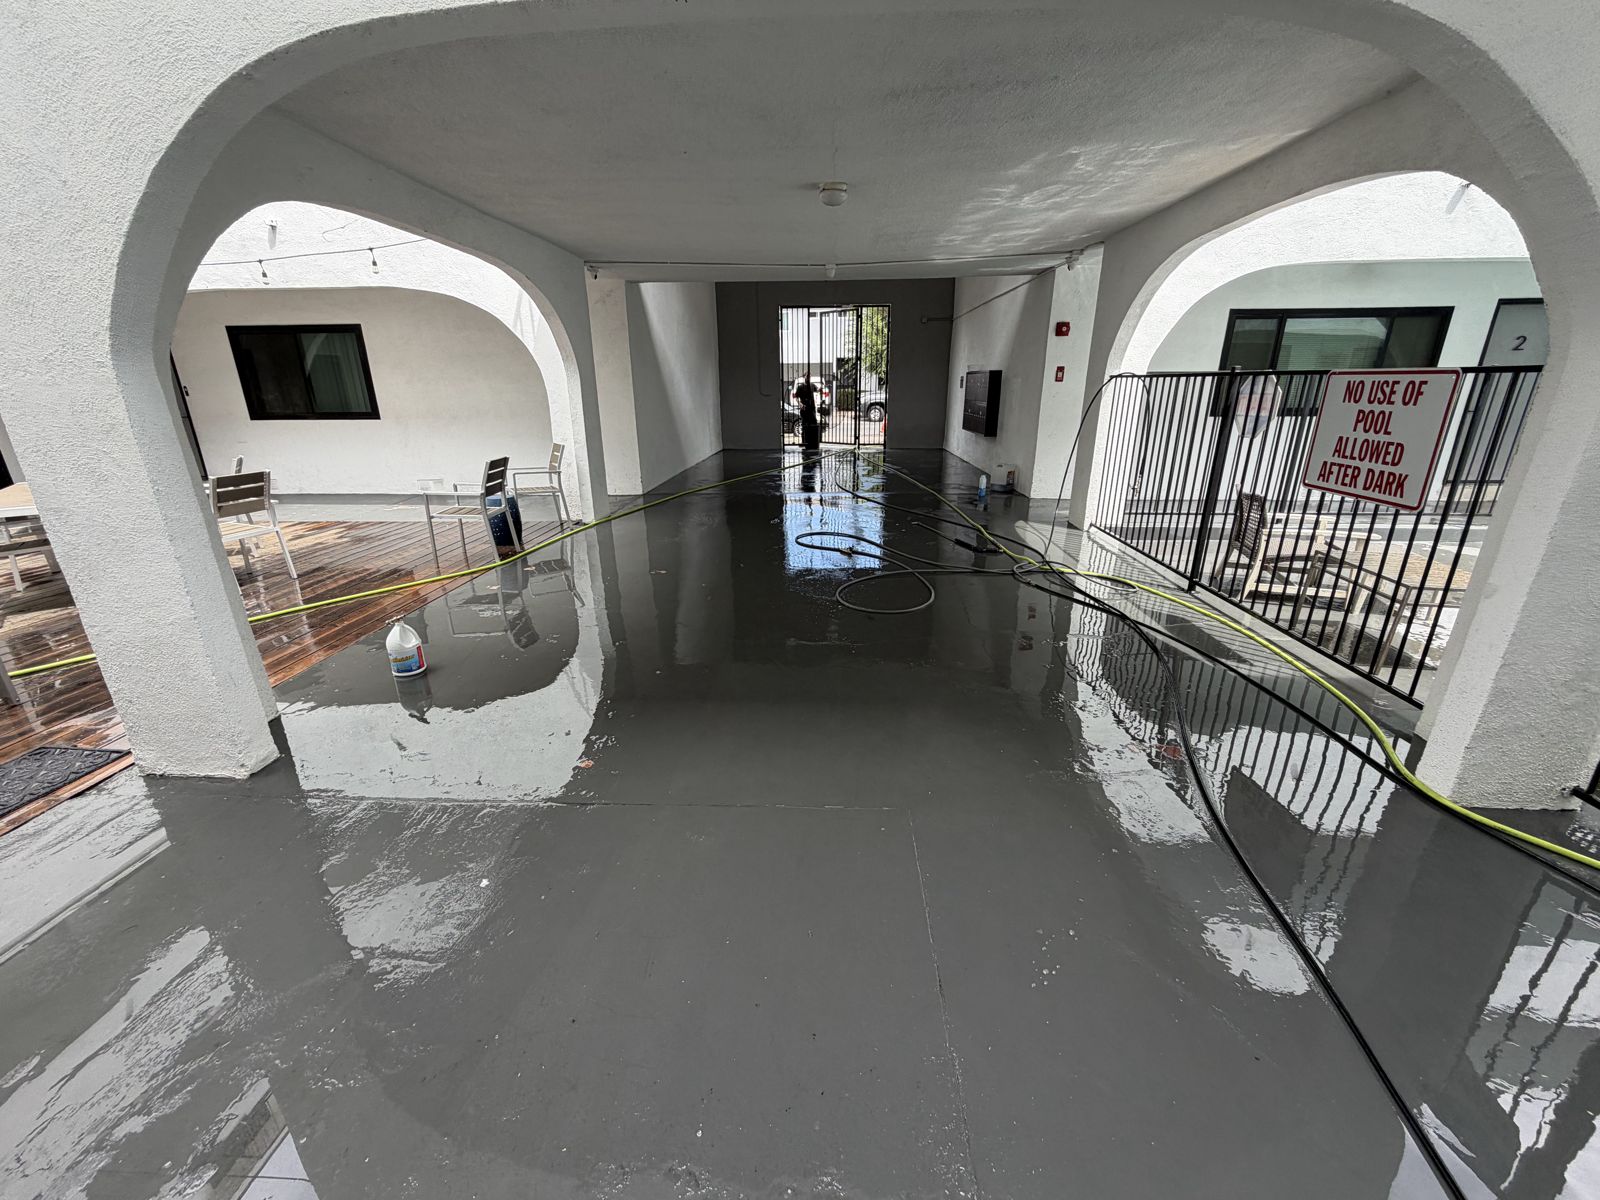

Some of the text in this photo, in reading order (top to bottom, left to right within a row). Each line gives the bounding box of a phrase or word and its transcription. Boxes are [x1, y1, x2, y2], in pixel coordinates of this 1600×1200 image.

[1511, 335, 1527, 351] 2
[1342, 380, 1428, 407] NO USE OF
[1353, 409, 1393, 436] POOL
[1332, 436, 1405, 467] ALLOWED
[1317, 461, 1409, 499] AFTER DARK
